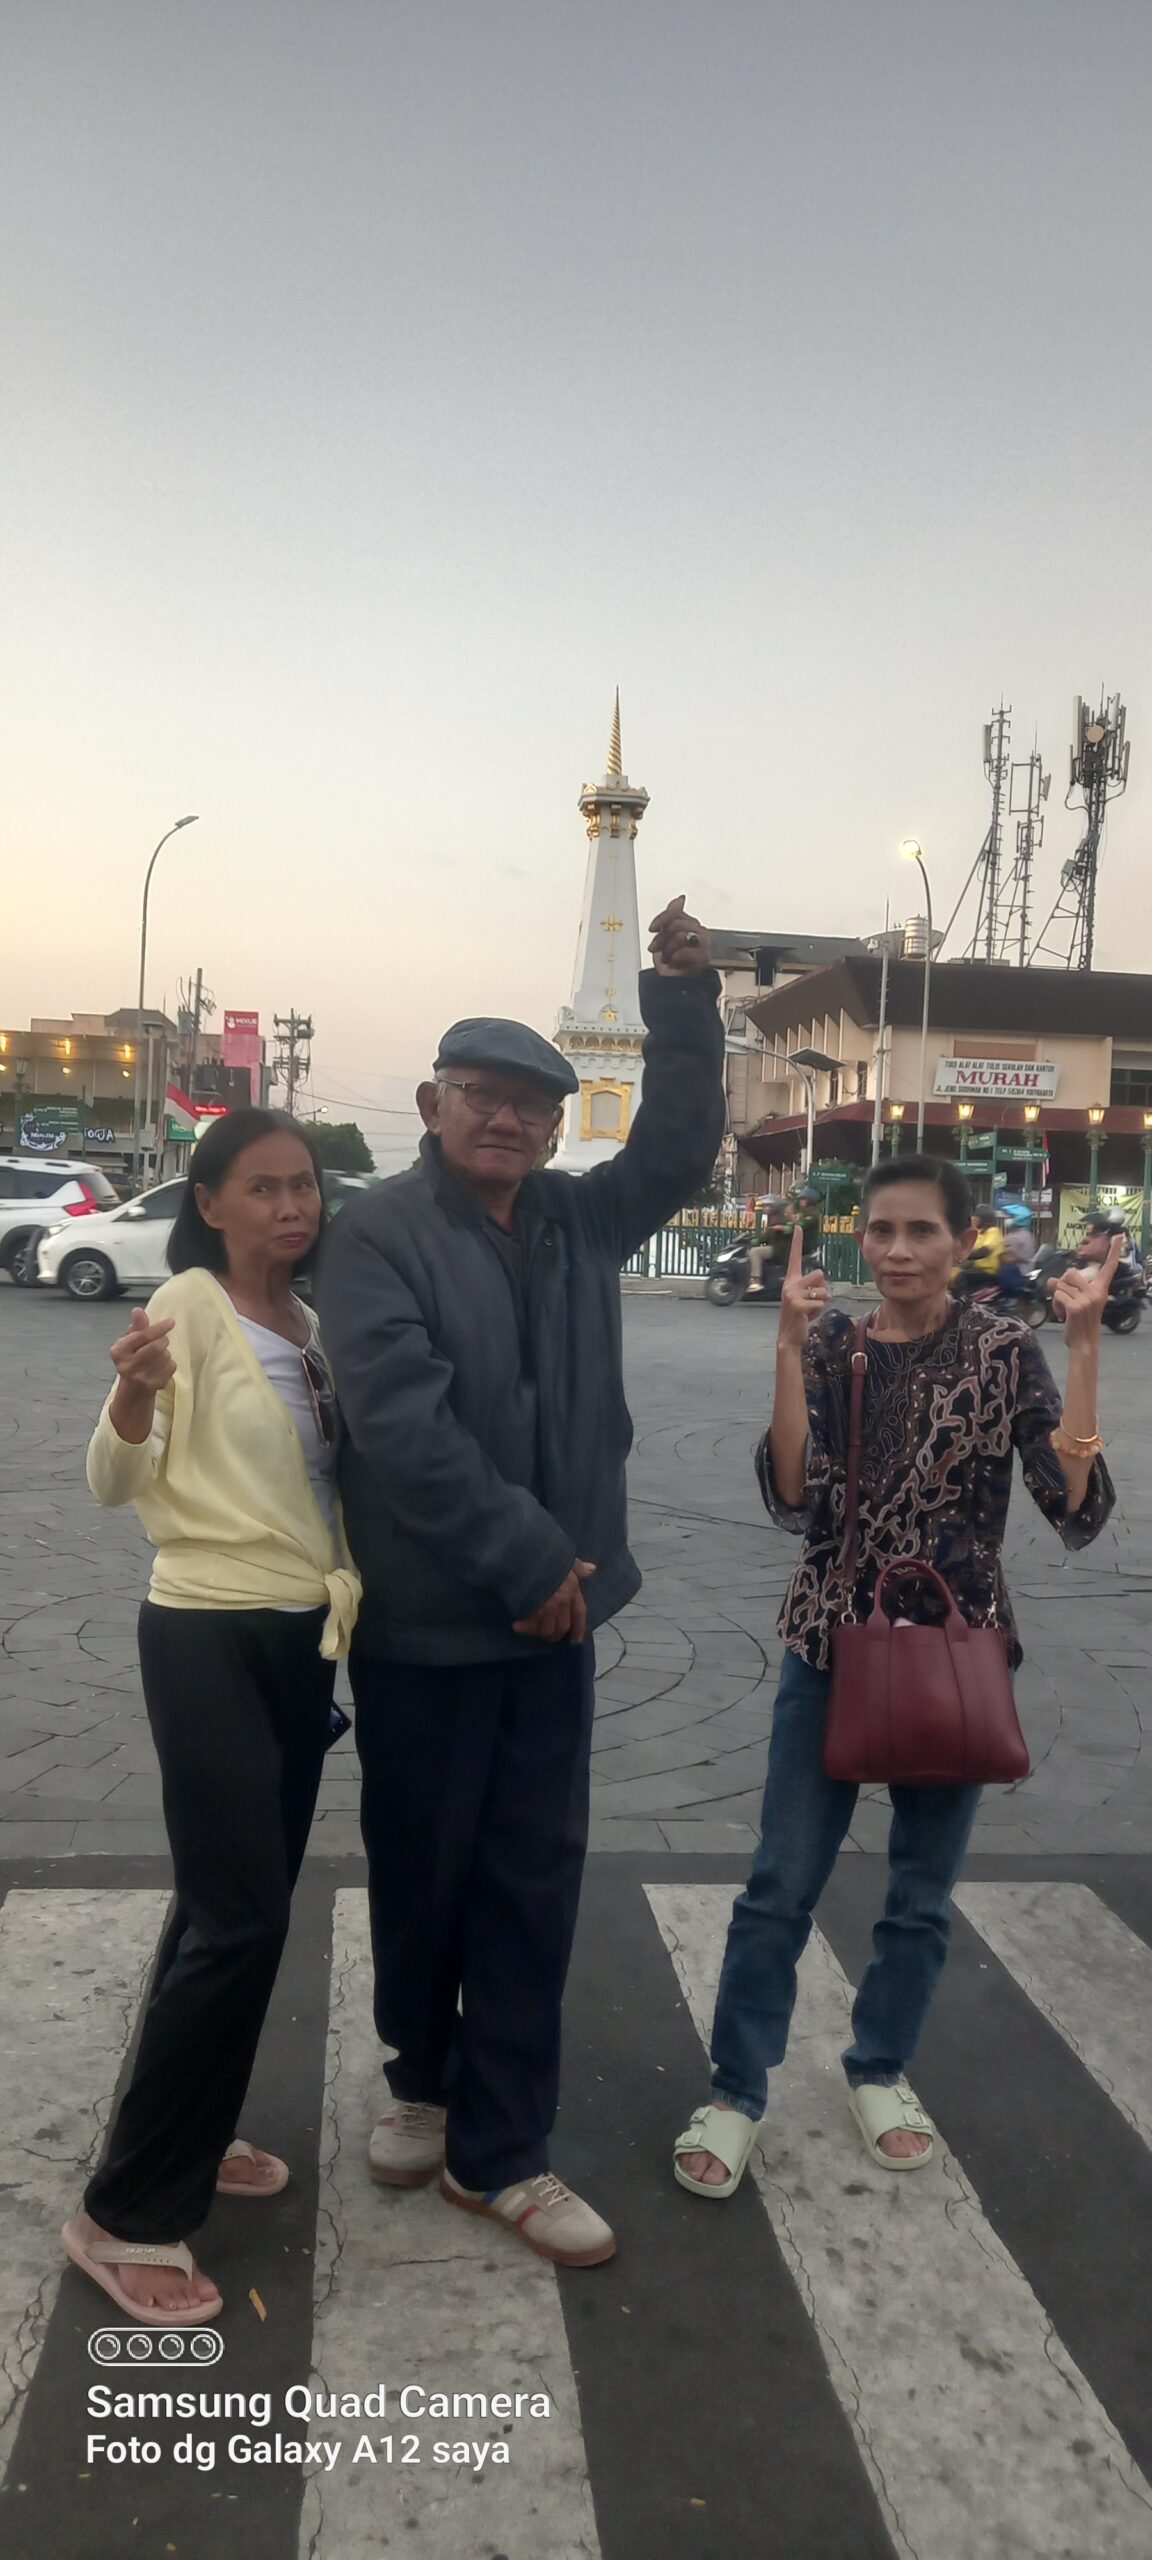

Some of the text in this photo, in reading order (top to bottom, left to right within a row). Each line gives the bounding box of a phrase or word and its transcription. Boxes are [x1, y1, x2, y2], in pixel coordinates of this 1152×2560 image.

[958, 1061, 971, 1069] ALAT
[972, 1061, 985, 1069] ALAT
[986, 1062, 1000, 1070] TULIS
[1002, 1063, 1024, 1071] SEKOLAH
[1024, 1064, 1035, 1072] DAN
[955, 1070, 1040, 1087] MURAH
